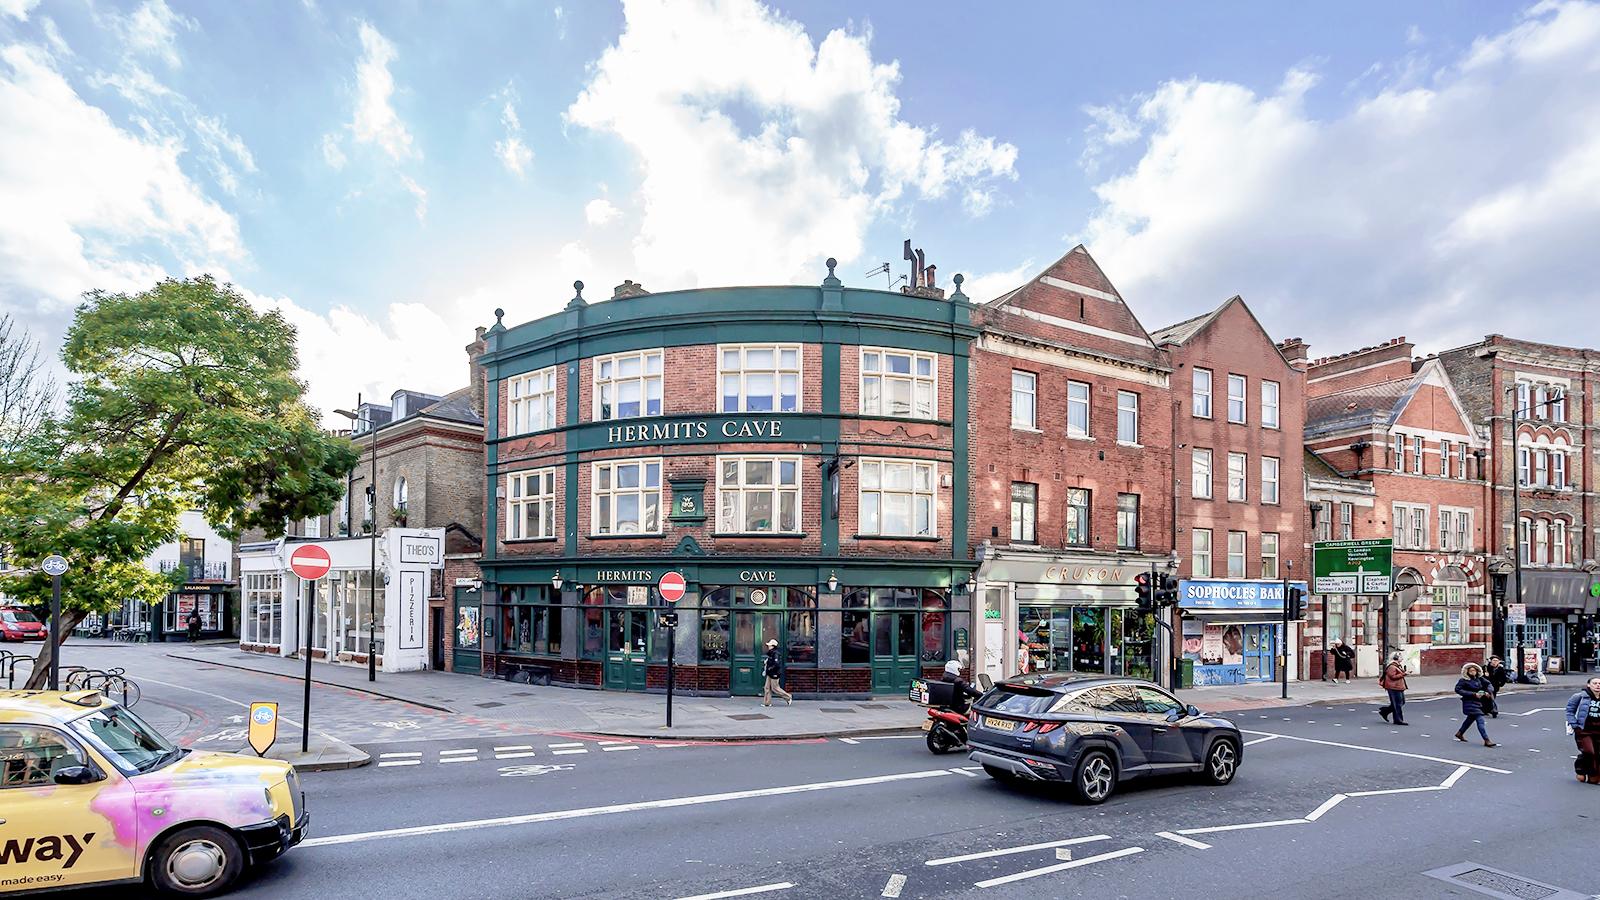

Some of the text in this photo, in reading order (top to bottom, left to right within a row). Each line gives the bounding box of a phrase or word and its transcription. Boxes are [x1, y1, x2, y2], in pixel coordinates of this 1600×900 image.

[607, 419, 783, 443] HERMITS CAVE
[406, 544, 435, 556] THEO'S
[597, 570, 776, 581] HERMITS CAVE
[1045, 566, 1124, 581] CRUSON
[1187, 585, 1285, 600] SOPHOCLES BAK
[1, 873, 65, 886] made easy.
